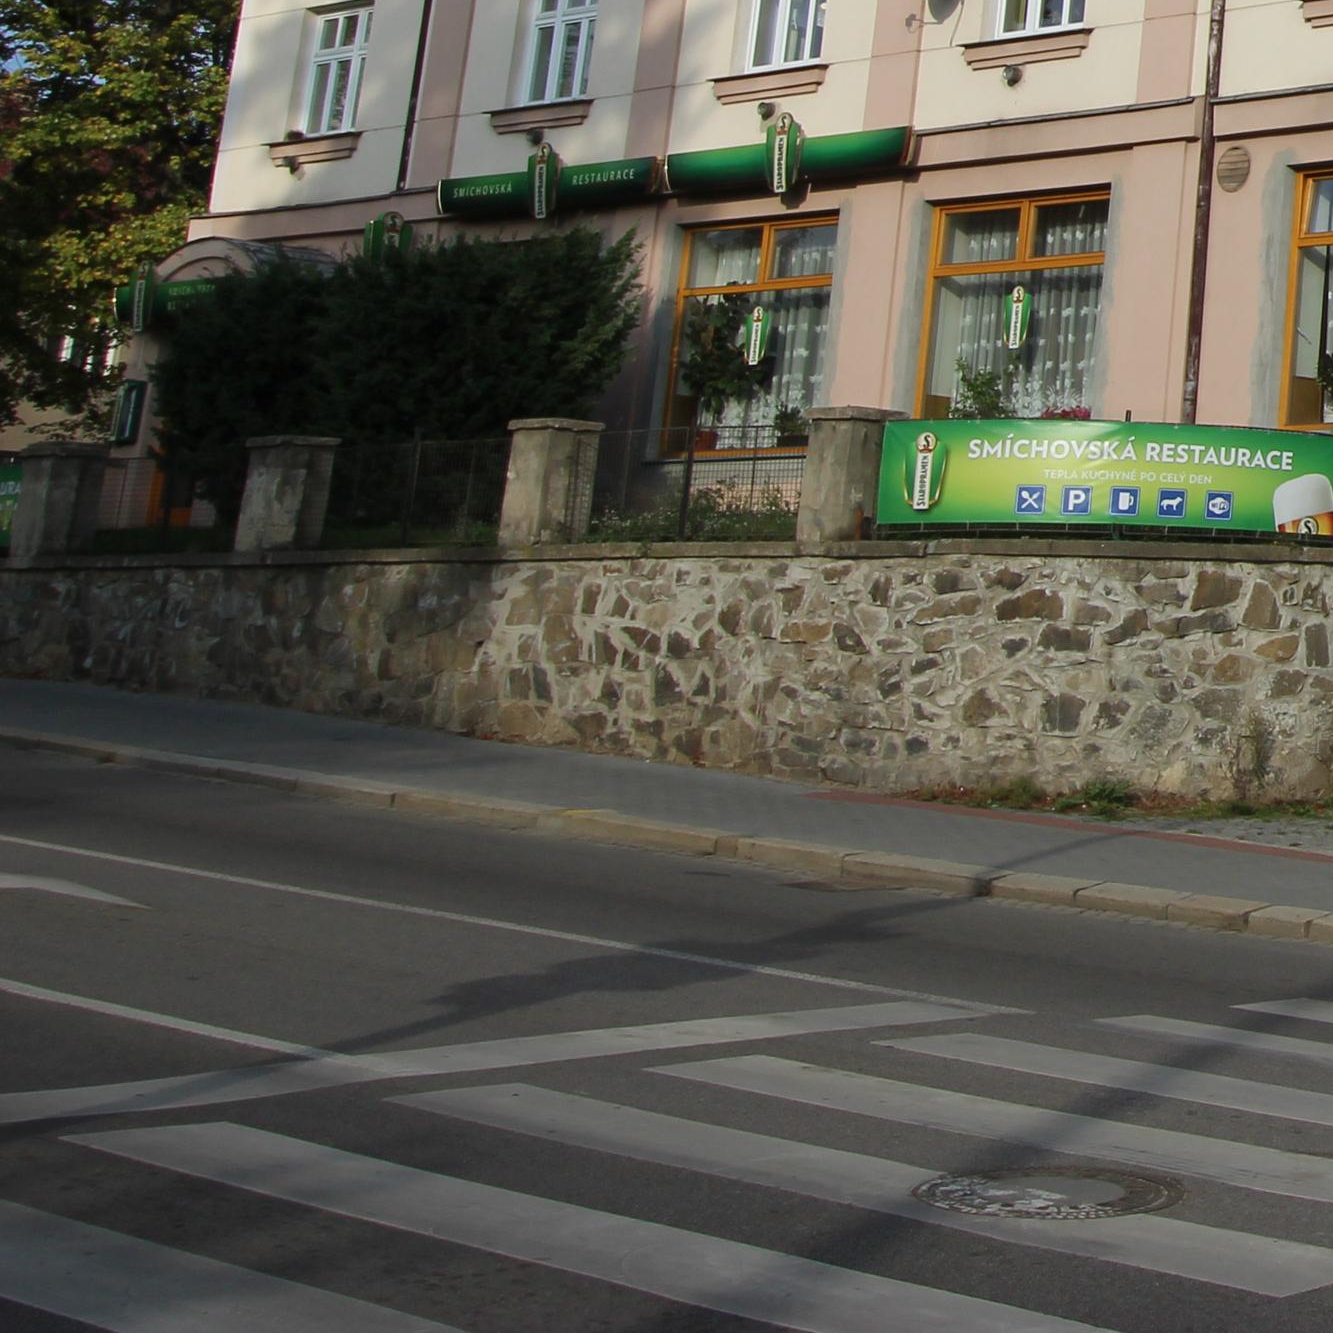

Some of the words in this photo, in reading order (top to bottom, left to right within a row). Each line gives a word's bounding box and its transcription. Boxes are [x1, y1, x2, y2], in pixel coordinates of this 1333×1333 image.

[452, 180, 513, 199] SMÍCHOVSKÁ
[571, 167, 636, 186] RESTAURACE
[967, 433, 1137, 461] SMÍCHOVSKÁ
[1145, 441, 1294, 471] RESTAURACE
[916, 454, 930, 507] STAROPRAMEN
[1140, 472, 1157, 482] PO
[1159, 471, 1186, 484] CELÝ
[1189, 474, 1213, 485] DEN
